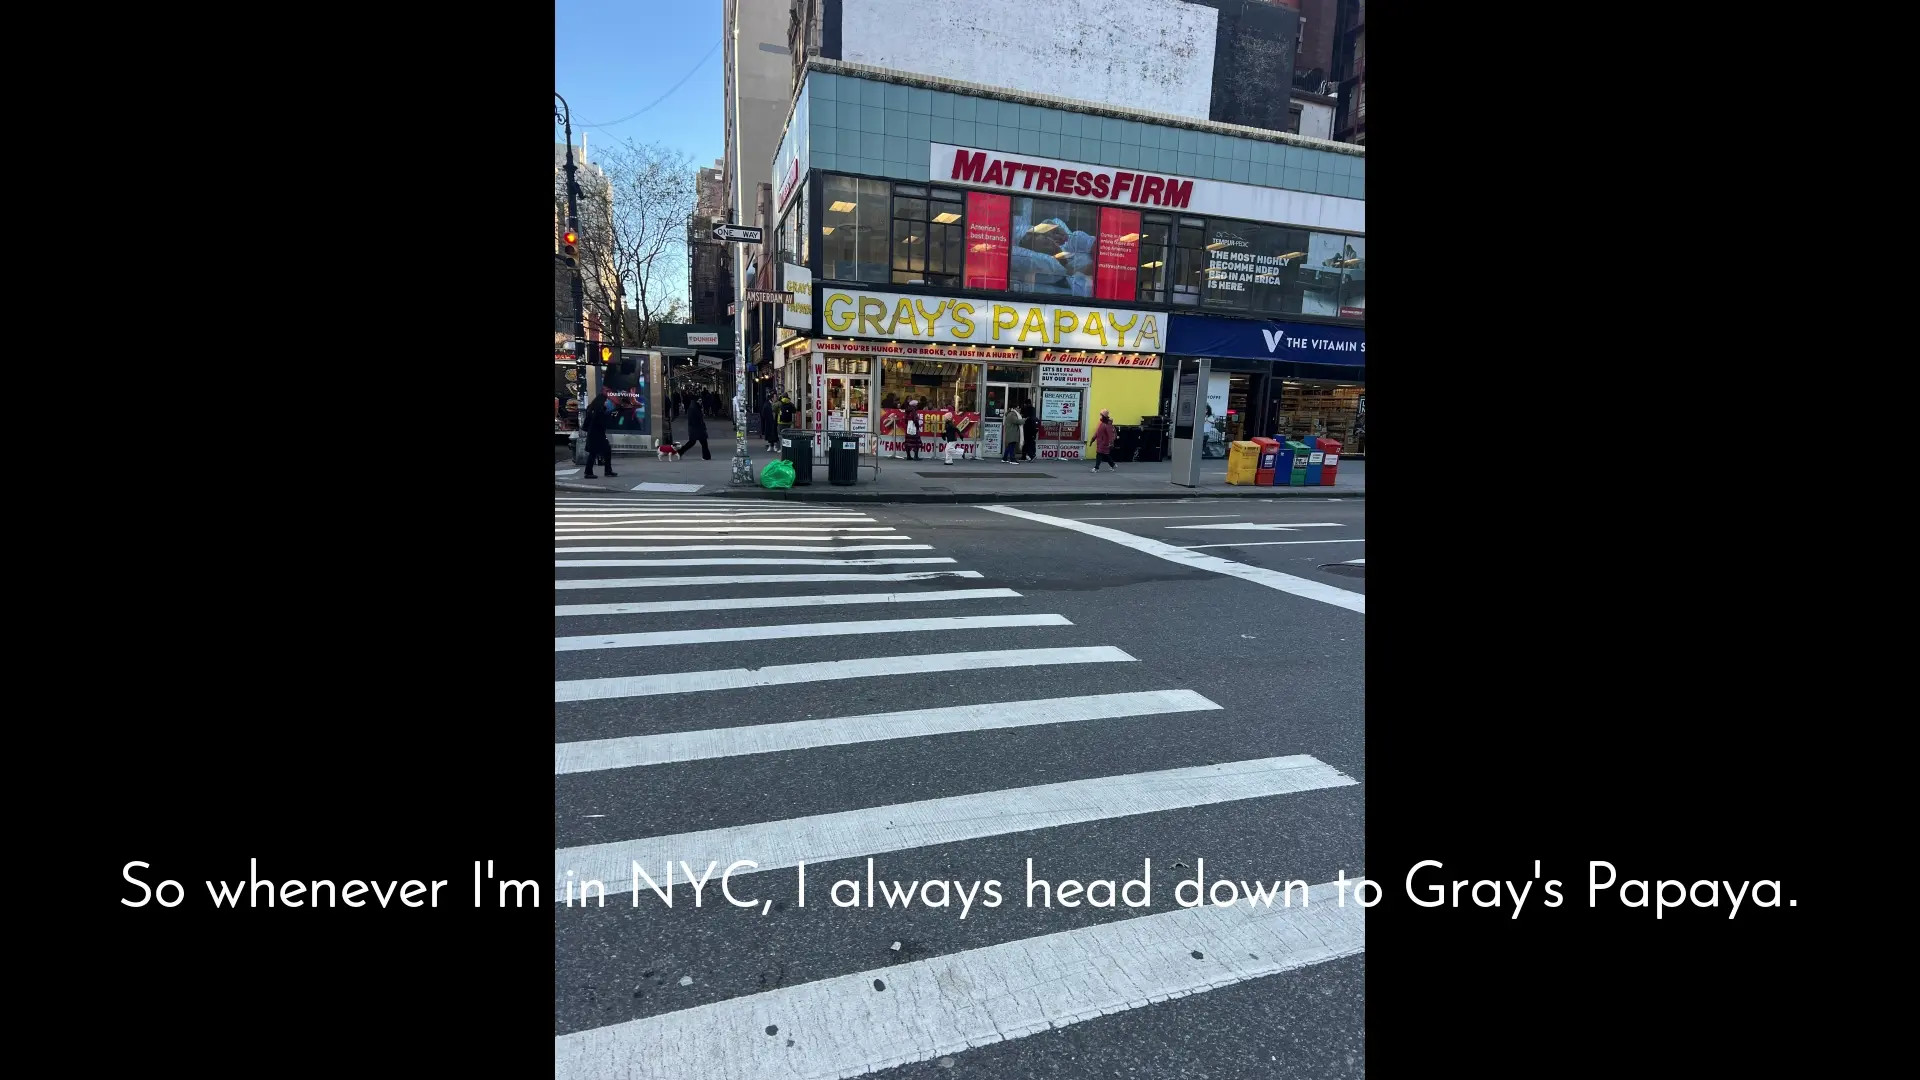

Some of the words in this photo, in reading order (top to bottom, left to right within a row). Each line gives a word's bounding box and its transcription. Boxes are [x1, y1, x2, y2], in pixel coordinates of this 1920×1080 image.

[717, 228, 735, 237] ONE
[742, 231, 758, 239] WAY
[970, 223, 1000, 232] America's
[985, 233, 1007, 242] brands
[1210, 250, 1229, 260] THE
[1230, 252, 1256, 263] MOST
[1257, 255, 1290, 267] HIGHLY
[1228, 272, 1239, 281] IN
[1207, 280, 1218, 289] IS
[1219, 281, 1246, 291] HERE.
[746, 291, 783, 303] AMSTERDAM
[785, 295, 793, 304] AV
[823, 293, 976, 339] GRAY'S
[991, 304, 1161, 349] PAPAYA
[817, 343, 841, 351] WHEN
[842, 344, 870, 352] YOU'RE
[871, 346, 905, 355] HUNGRY,
[919, 349, 946, 357] BROKE,
[992, 351, 1019, 359] HURRY!
[1286, 337, 1308, 349] THE
[1311, 338, 1357, 352] VITAMIN
[1043, 353, 1057, 362] No
[1059, 354, 1108, 365] Gimmicks!
[1117, 356, 1130, 365] No
[1132, 357, 1157, 366] Bull!
[814, 364, 823, 446] WELCOME
[1041, 450, 1059, 458] HOT
[1060, 450, 1079, 458] DOG
